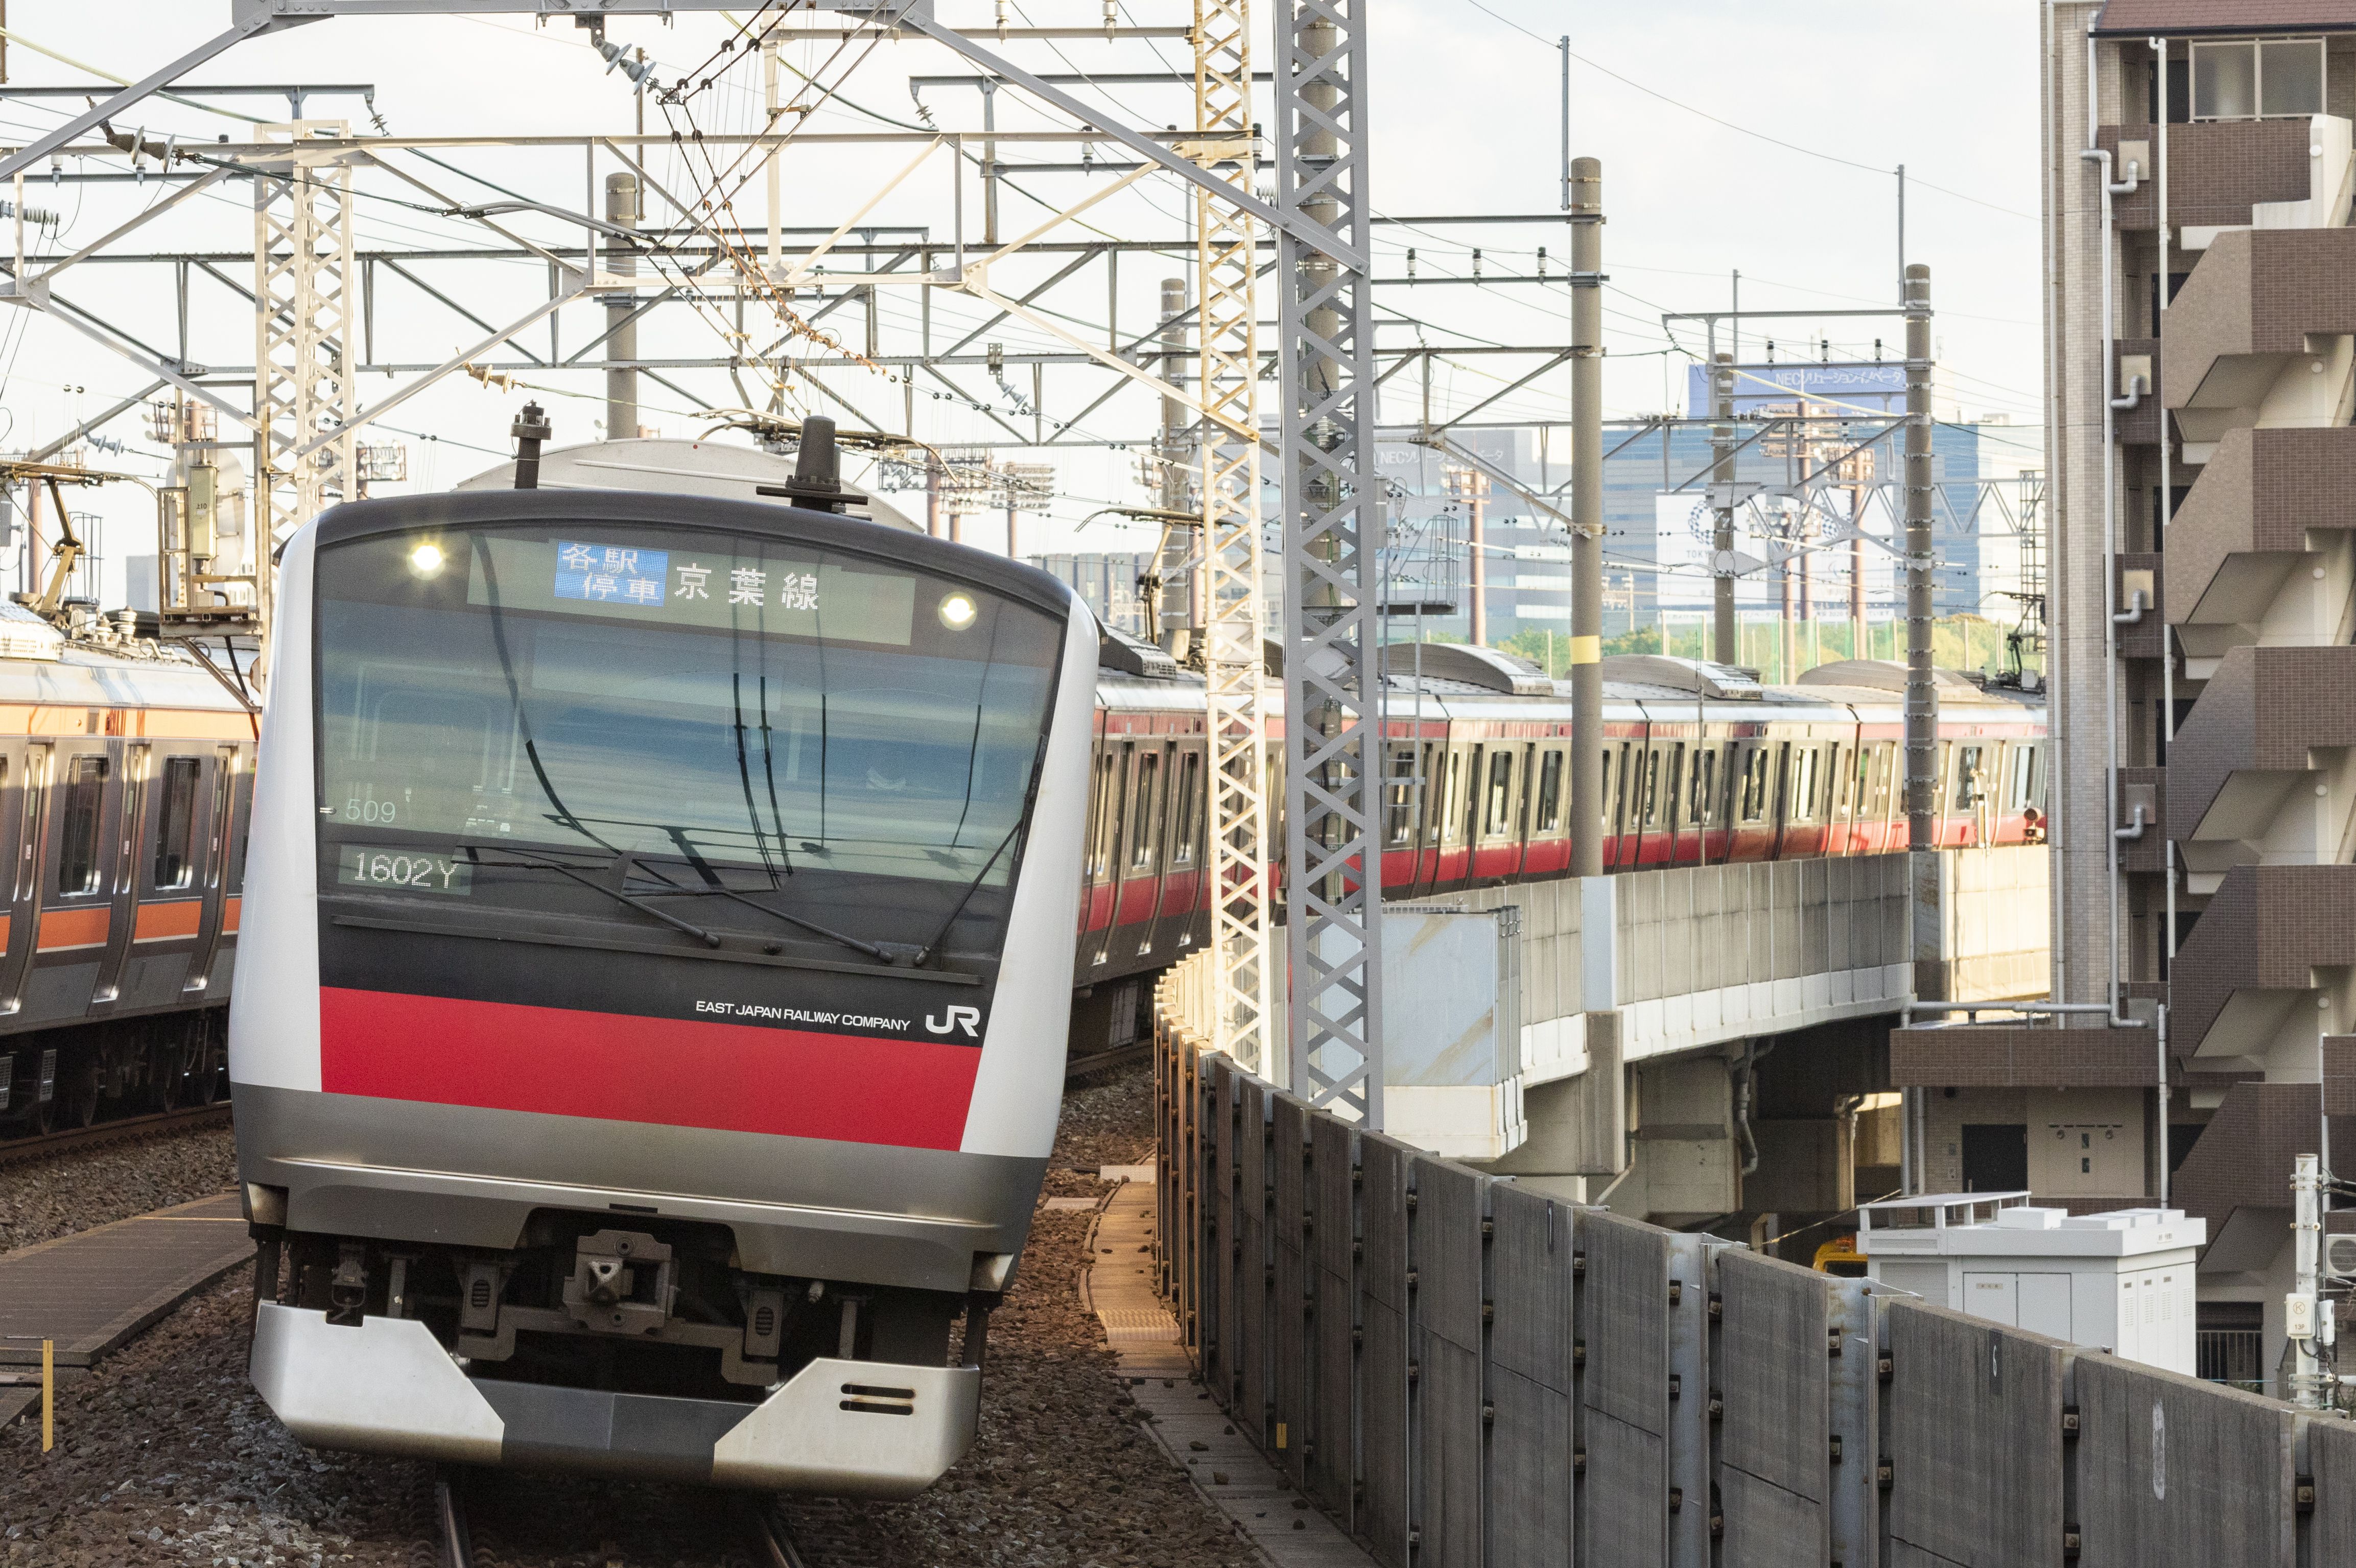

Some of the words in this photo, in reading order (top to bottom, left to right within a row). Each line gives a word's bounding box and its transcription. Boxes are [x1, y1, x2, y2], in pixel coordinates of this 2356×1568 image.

[562, 543, 638, 575] 各駅
[1686, 550, 1709, 558] TOKY
[583, 572, 659, 603] 停車
[674, 563, 819, 610] 京葉線
[346, 799, 395, 823] 509
[355, 853, 458, 888] 1602Y
[696, 1001, 735, 1014] EAST
[736, 1005, 781, 1019] JAPAN
[784, 1009, 840, 1024] RAILWAY
[842, 1014, 910, 1031] COMPANY
[925, 1005, 980, 1037] JR
